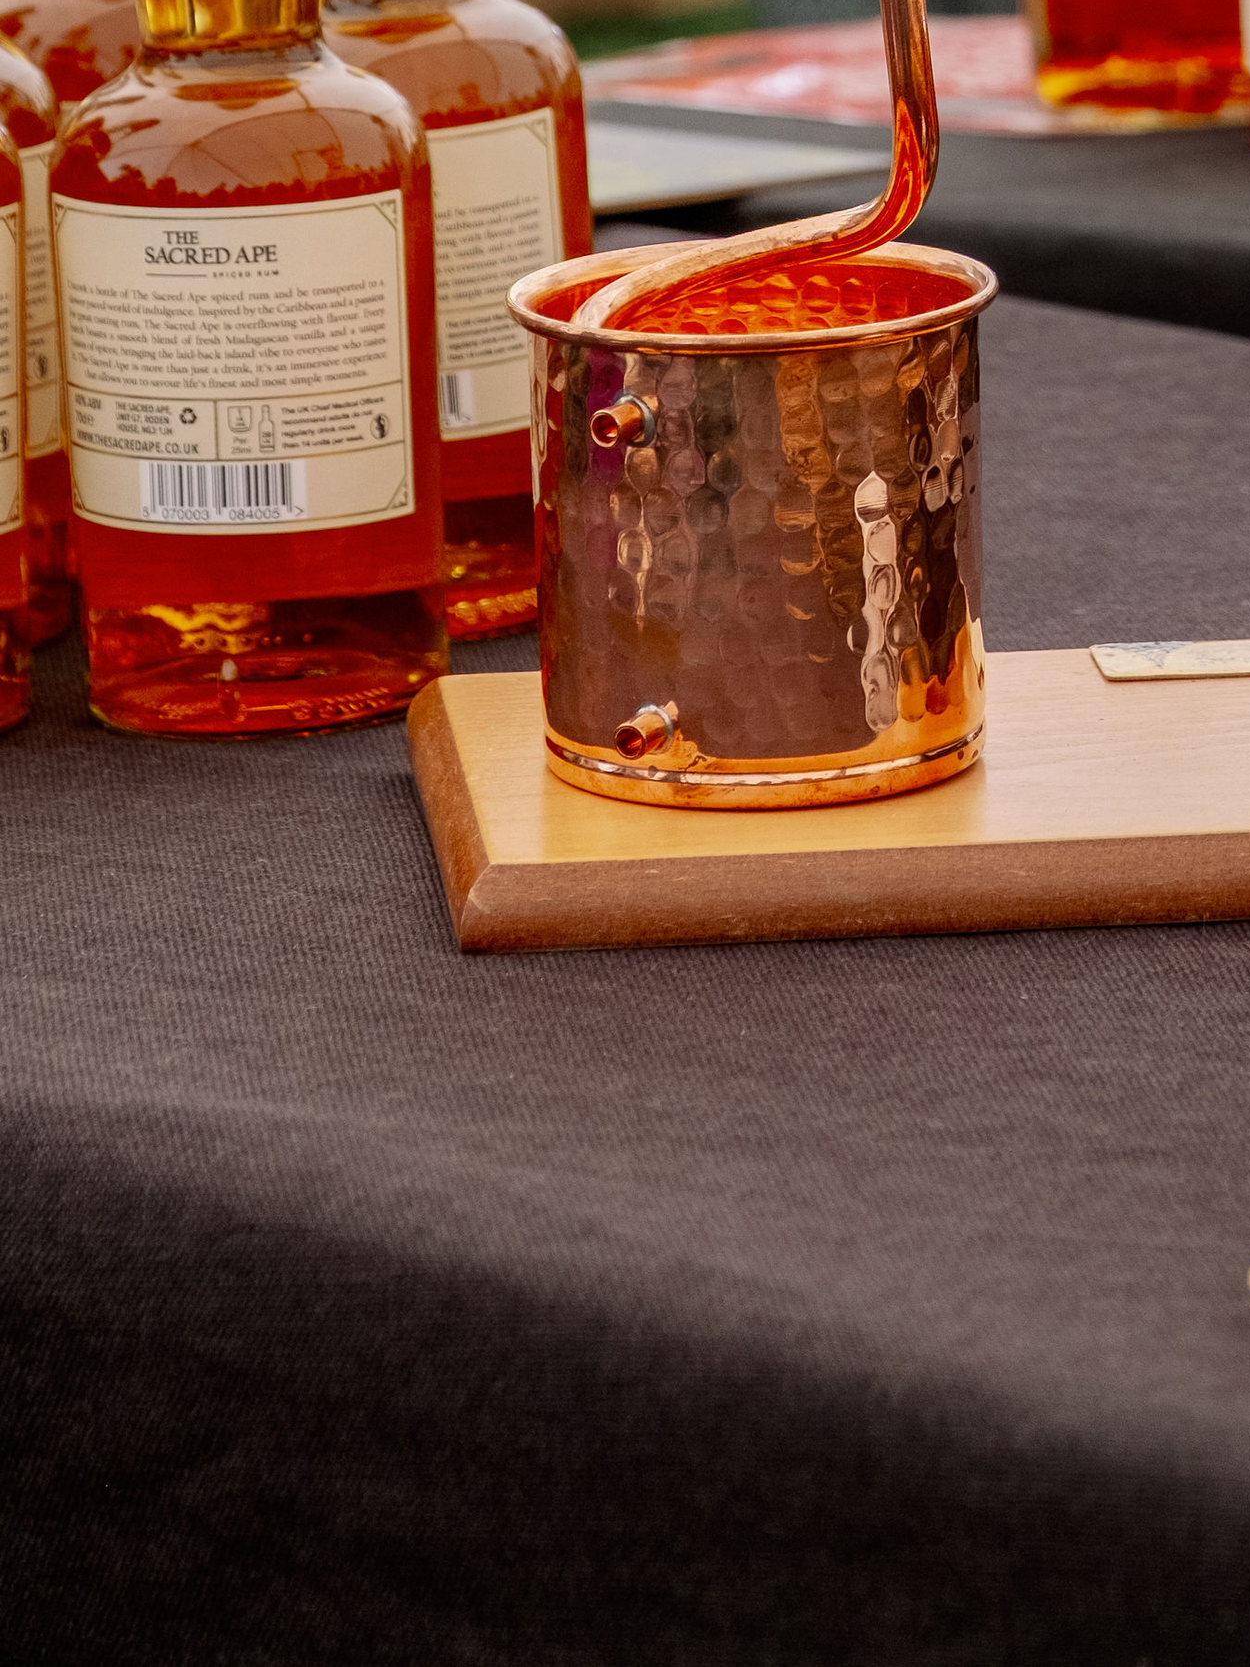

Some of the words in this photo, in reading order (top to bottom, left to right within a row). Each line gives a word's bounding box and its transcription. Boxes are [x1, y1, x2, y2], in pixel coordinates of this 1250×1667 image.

[163, 230, 200, 245] THE
[145, 246, 230, 265] SACRED
[234, 245, 278, 263] APE
[120, 289, 128, 299] of
[131, 290, 148, 301] The
[152, 290, 183, 302] Sacred
[187, 292, 207, 304] Ape
[211, 291, 244, 304] spiced
[248, 293, 270, 301] rum
[274, 288, 293, 299] and
[297, 287, 308, 297] be
[312, 279, 366, 295] transported
[368, 280, 377, 288] to
[132, 305, 141, 314] of
[198, 306, 241, 319] Inspired
[243, 305, 256, 317] by
[258, 304, 274, 314] the
[276, 300, 327, 314] Caribbean
[330, 297, 346, 308] and
[355, 294, 385, 308] passion
[144, 319, 160, 330] The
[164, 320, 196, 331] Sacred
[200, 321, 220, 333] Ape
[223, 321, 232, 330] is
[235, 318, 297, 330] overflowing
[300, 315, 324, 325] with
[363, 308, 385, 319] Every
[117, 334, 147, 343] smooth
[151, 333, 178, 345] blend
[181, 335, 191, 345] of
[195, 335, 221, 345] fresh
[225, 334, 289, 346] Madagascan
[293, 329, 325, 341] vanilla
[330, 327, 347, 338] and
[120, 346, 156, 360] bringing
[158, 349, 174, 359] the
[224, 348, 255, 359] island
[258, 347, 280, 357] vibe
[282, 348, 294, 356] to
[296, 344, 340, 355] everyone
[342, 339, 362, 350] who
[114, 360, 129, 372] Ape
[131, 363, 139, 371] is
[141, 364, 164, 372] more
[166, 363, 188, 374] than
[190, 365, 209, 376] just
[221, 363, 253, 374] drink,
[256, 363, 272, 372] it's
[275, 363, 288, 371] an
[290, 357, 340, 370] immersive
[342, 352, 387, 366] experience
[122, 377, 138, 386] you
[139, 377, 149, 385] to
[150, 379, 181, 388] savour
[183, 378, 206, 388] life's
[208, 378, 237, 388] finest
[241, 377, 259, 387] and
[262, 378, 287, 387] most
[290, 372, 322, 386] simple
[115, 401, 126, 411] THE
[128, 402, 155, 414] SACRED
[281, 407, 295, 415] The
[311, 403, 331, 412] Chief
[77, 429, 200, 455] WWW.THESACREDAPE.CO.UK
[161, 508, 210, 521] 070003
[228, 507, 281, 521] 084005
